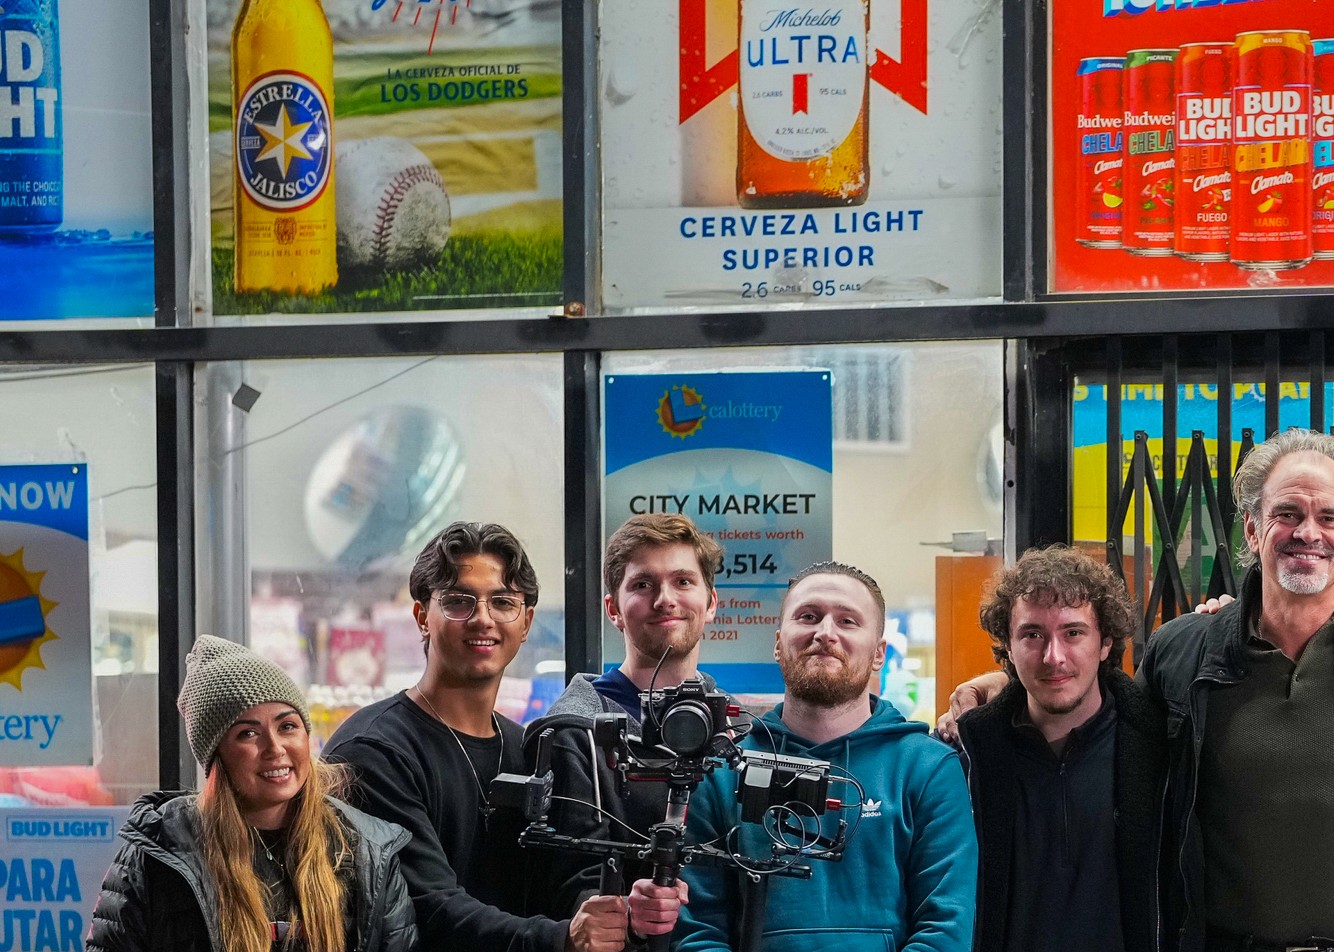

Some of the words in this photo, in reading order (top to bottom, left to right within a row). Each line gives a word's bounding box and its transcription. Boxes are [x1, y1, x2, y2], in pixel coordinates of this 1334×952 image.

[760, 9, 842, 32] Michelob
[387, 68, 402, 80] LA
[406, 67, 455, 79] CERVEZA
[459, 65, 503, 76] OFICIAL
[507, 64, 521, 74] DE
[381, 83, 421, 102] LOS
[428, 78, 528, 101] DODGERS
[244, 84, 322, 124] ESTRELLA
[1244, 91, 1301, 114] BUD
[1236, 114, 1308, 137] LIGHT
[250, 171, 317, 198] JALISCO
[1250, 171, 1294, 194] Clamato
[679, 214, 819, 239] CERVEZA
[834, 210, 923, 233] LIGHT
[1196, 213, 1228, 222] FUEGO
[1254, 217, 1289, 227] MANGO
[722, 246, 874, 270] SUPERIOR
[812, 280, 835, 296] 95
[839, 283, 862, 292] CALS
[708, 399, 783, 422] calottery
[629, 495, 690, 515] CITY
[698, 493, 816, 514] MARKET
[718, 529, 761, 540] tickets
[765, 529, 804, 540] worth
[730, 598, 761, 609] from
[710, 630, 738, 640] 2021
[11, 821, 50, 836] BUD
[53, 821, 109, 836] LIGHT
